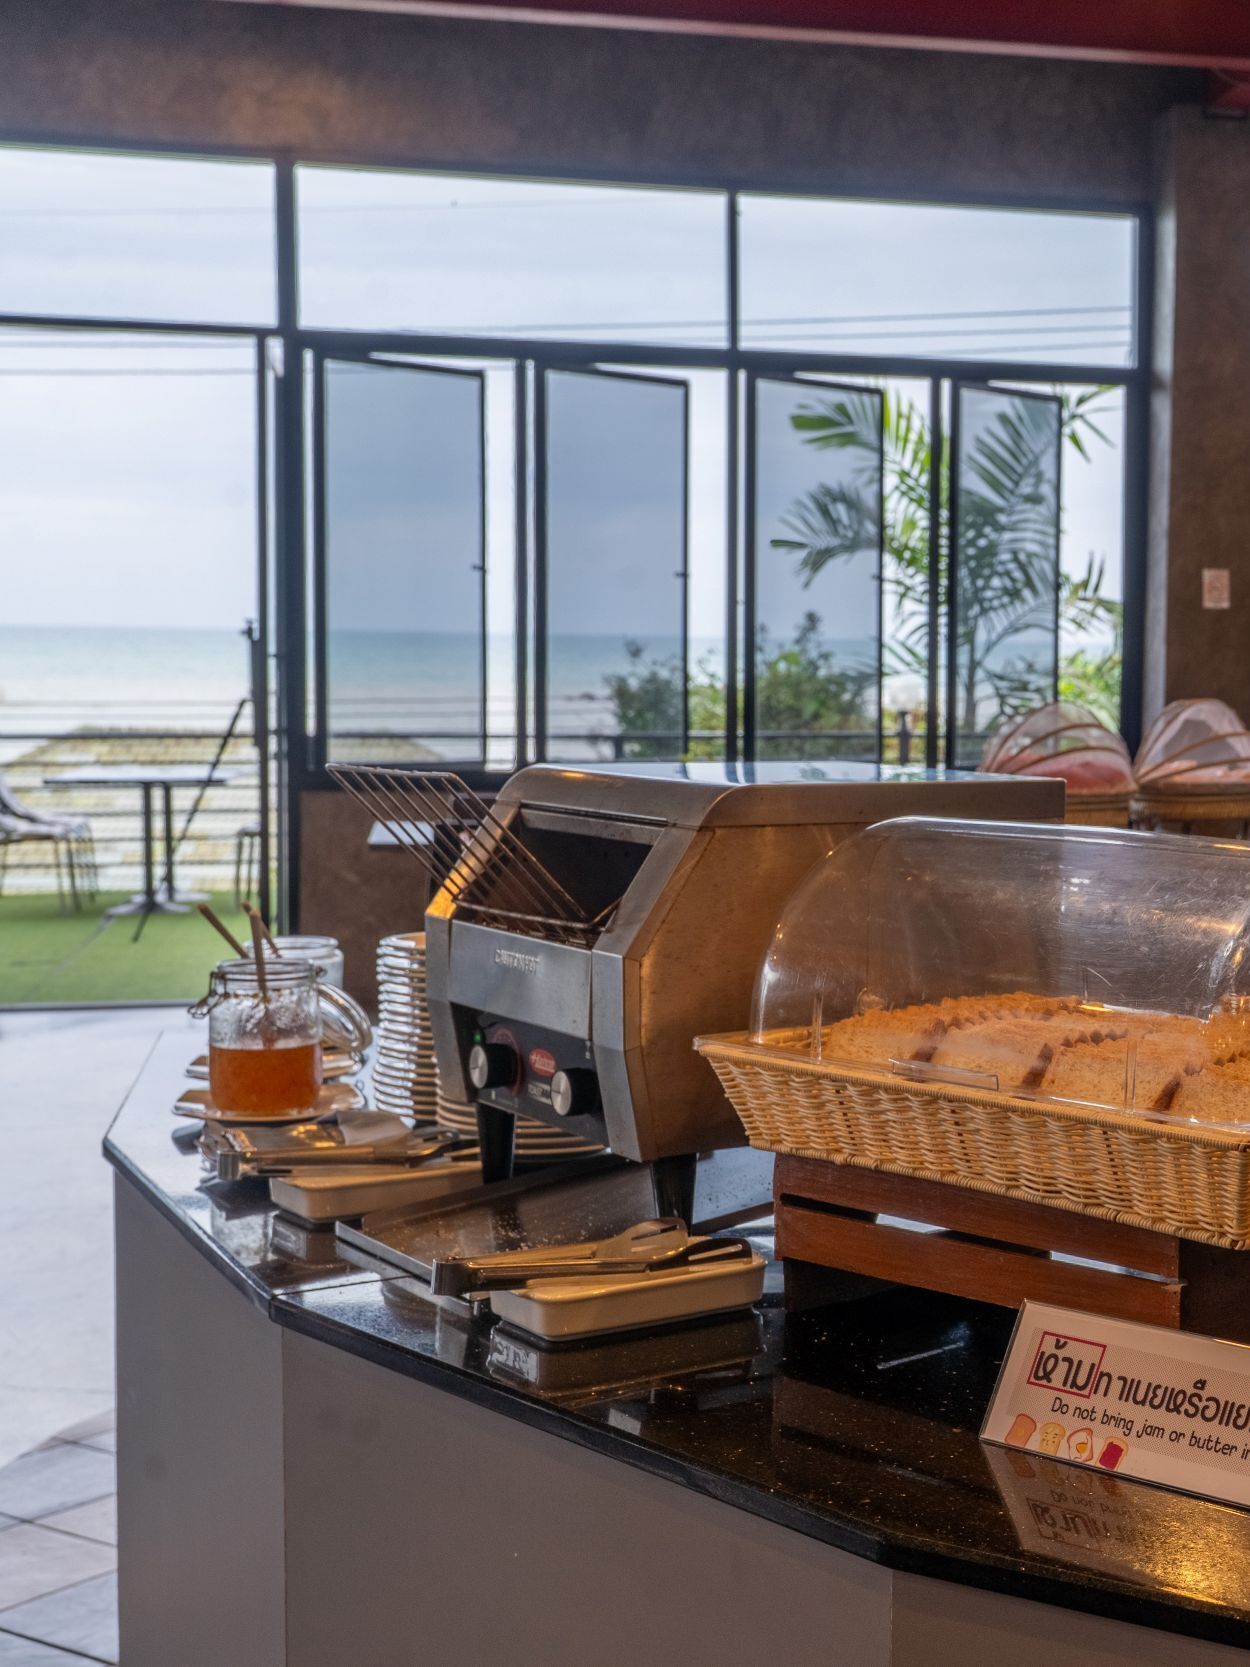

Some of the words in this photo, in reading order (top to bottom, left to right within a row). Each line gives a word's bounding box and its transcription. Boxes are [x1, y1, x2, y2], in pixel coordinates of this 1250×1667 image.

[1051, 1396, 1070, 1415] Do
[1072, 1405, 1097, 1422] not
[1101, 1409, 1135, 1437] bring
[1136, 1419, 1165, 1439] jam
[1169, 1429, 1185, 1444] or
[1188, 1431, 1238, 1456] butter
